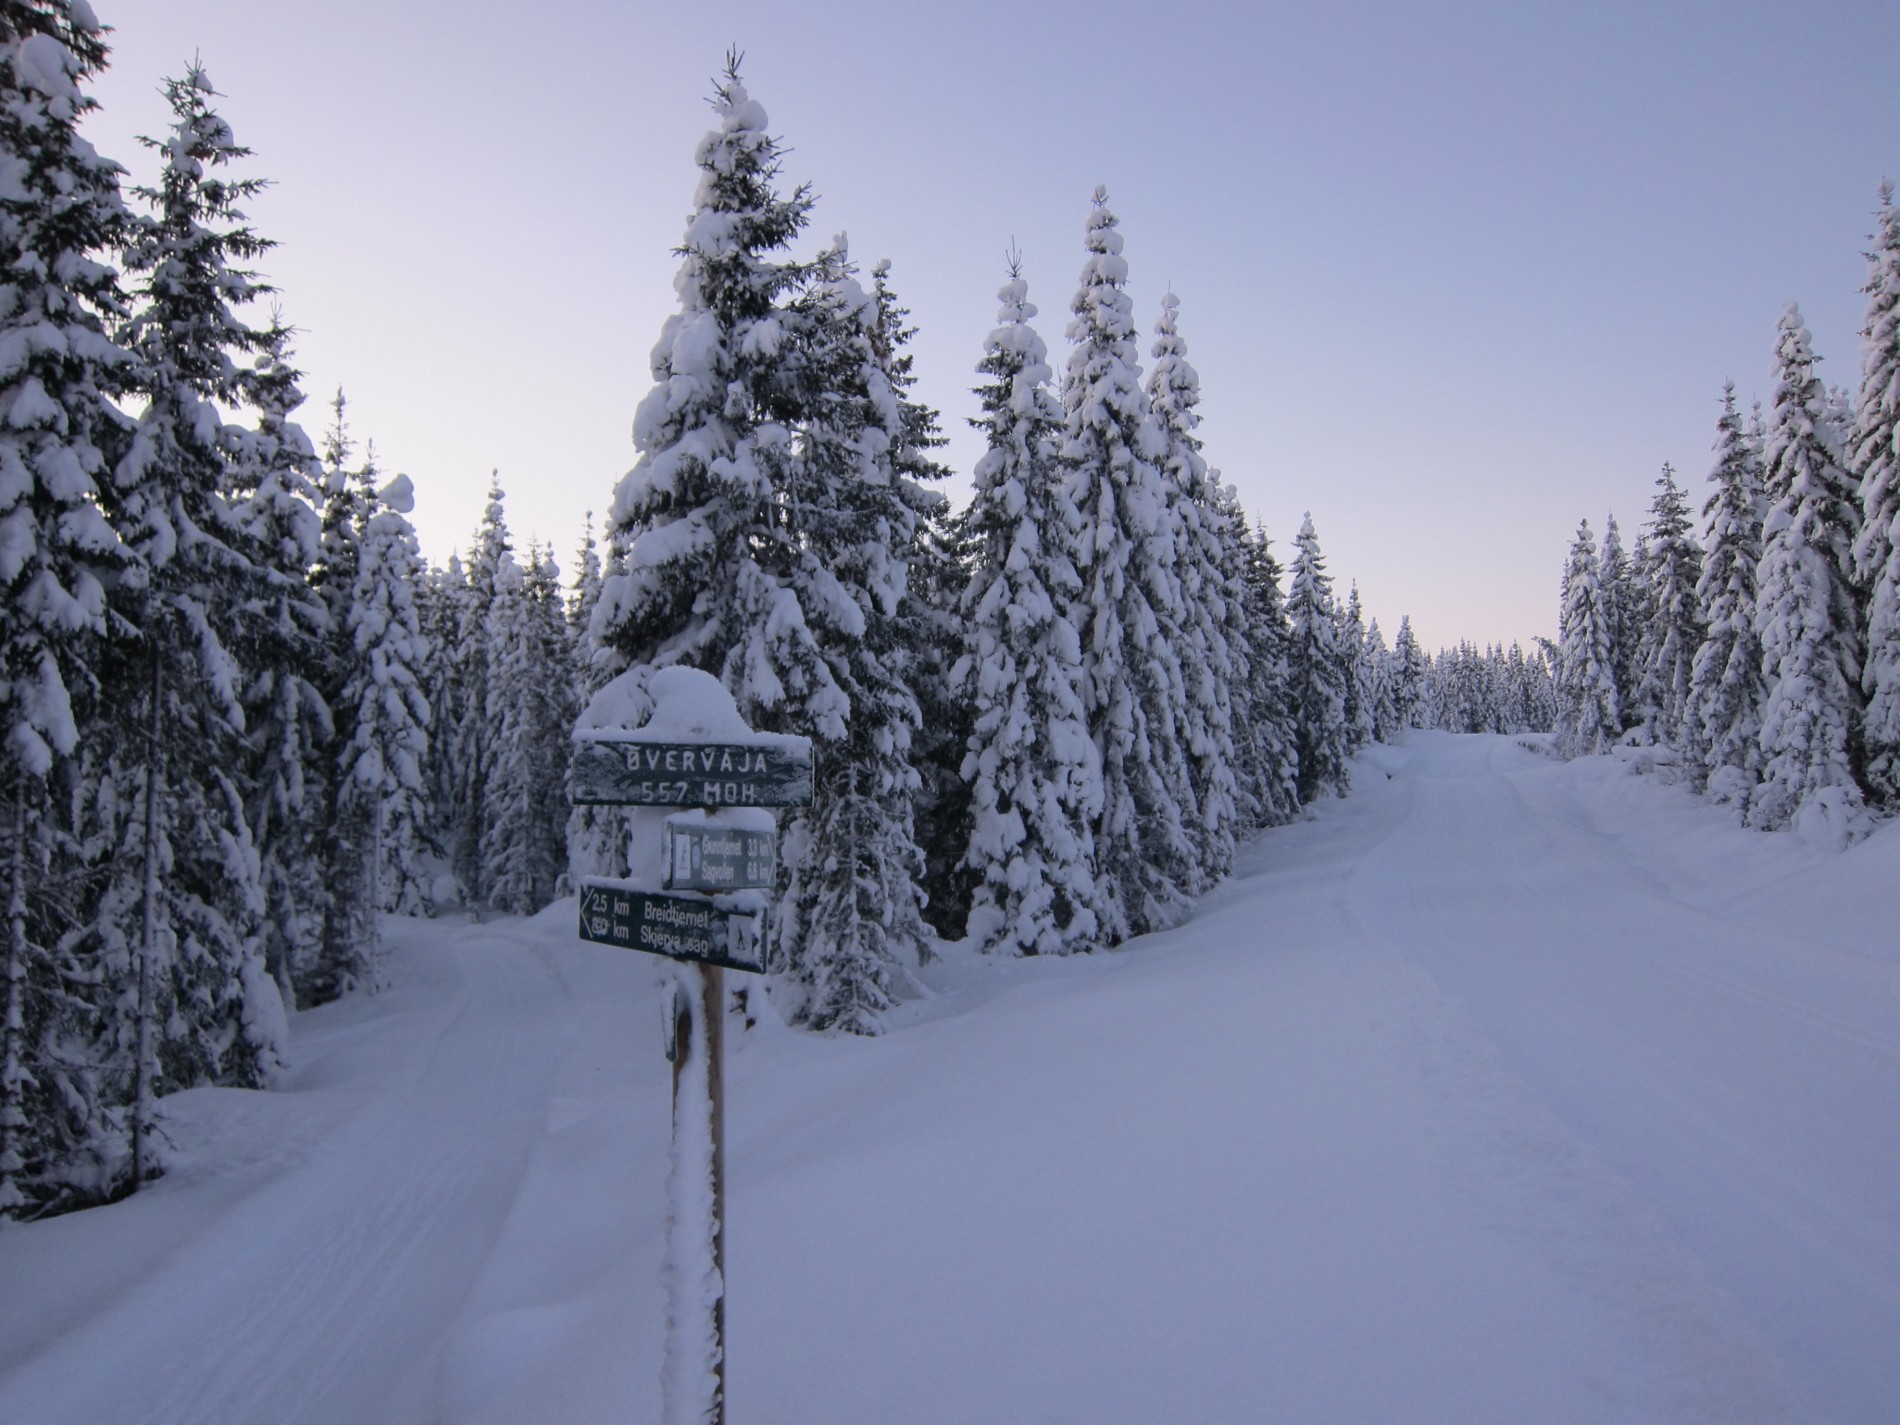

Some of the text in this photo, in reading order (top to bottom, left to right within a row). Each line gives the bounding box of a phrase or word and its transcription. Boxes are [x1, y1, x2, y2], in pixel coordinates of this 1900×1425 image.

[641, 781, 688, 803] 557
[614, 896, 629, 916] km
[613, 920, 629, 940] km
[687, 938, 709, 958] sag
